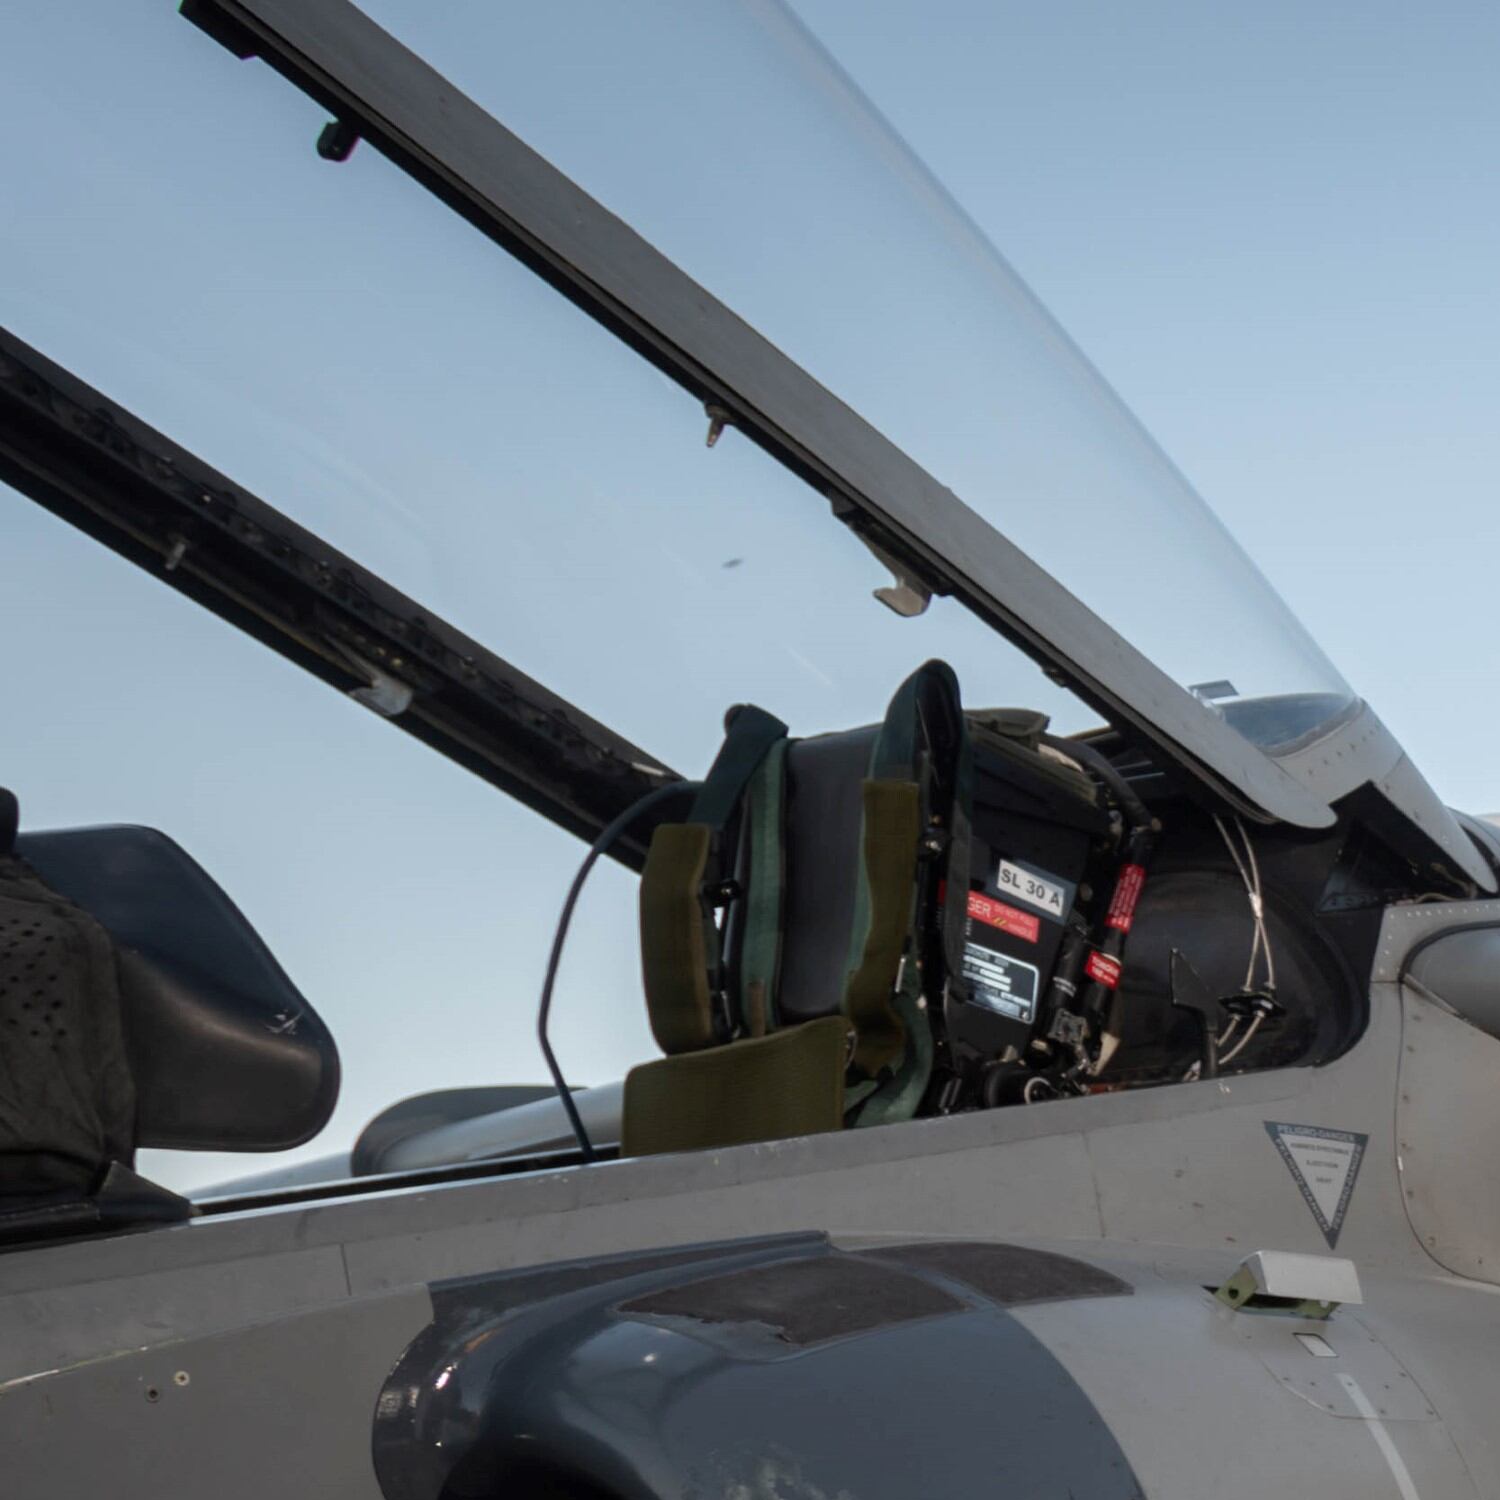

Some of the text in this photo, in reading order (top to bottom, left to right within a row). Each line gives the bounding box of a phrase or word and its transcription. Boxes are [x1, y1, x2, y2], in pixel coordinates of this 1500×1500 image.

[1001, 868, 1060, 907] SL 30 A
